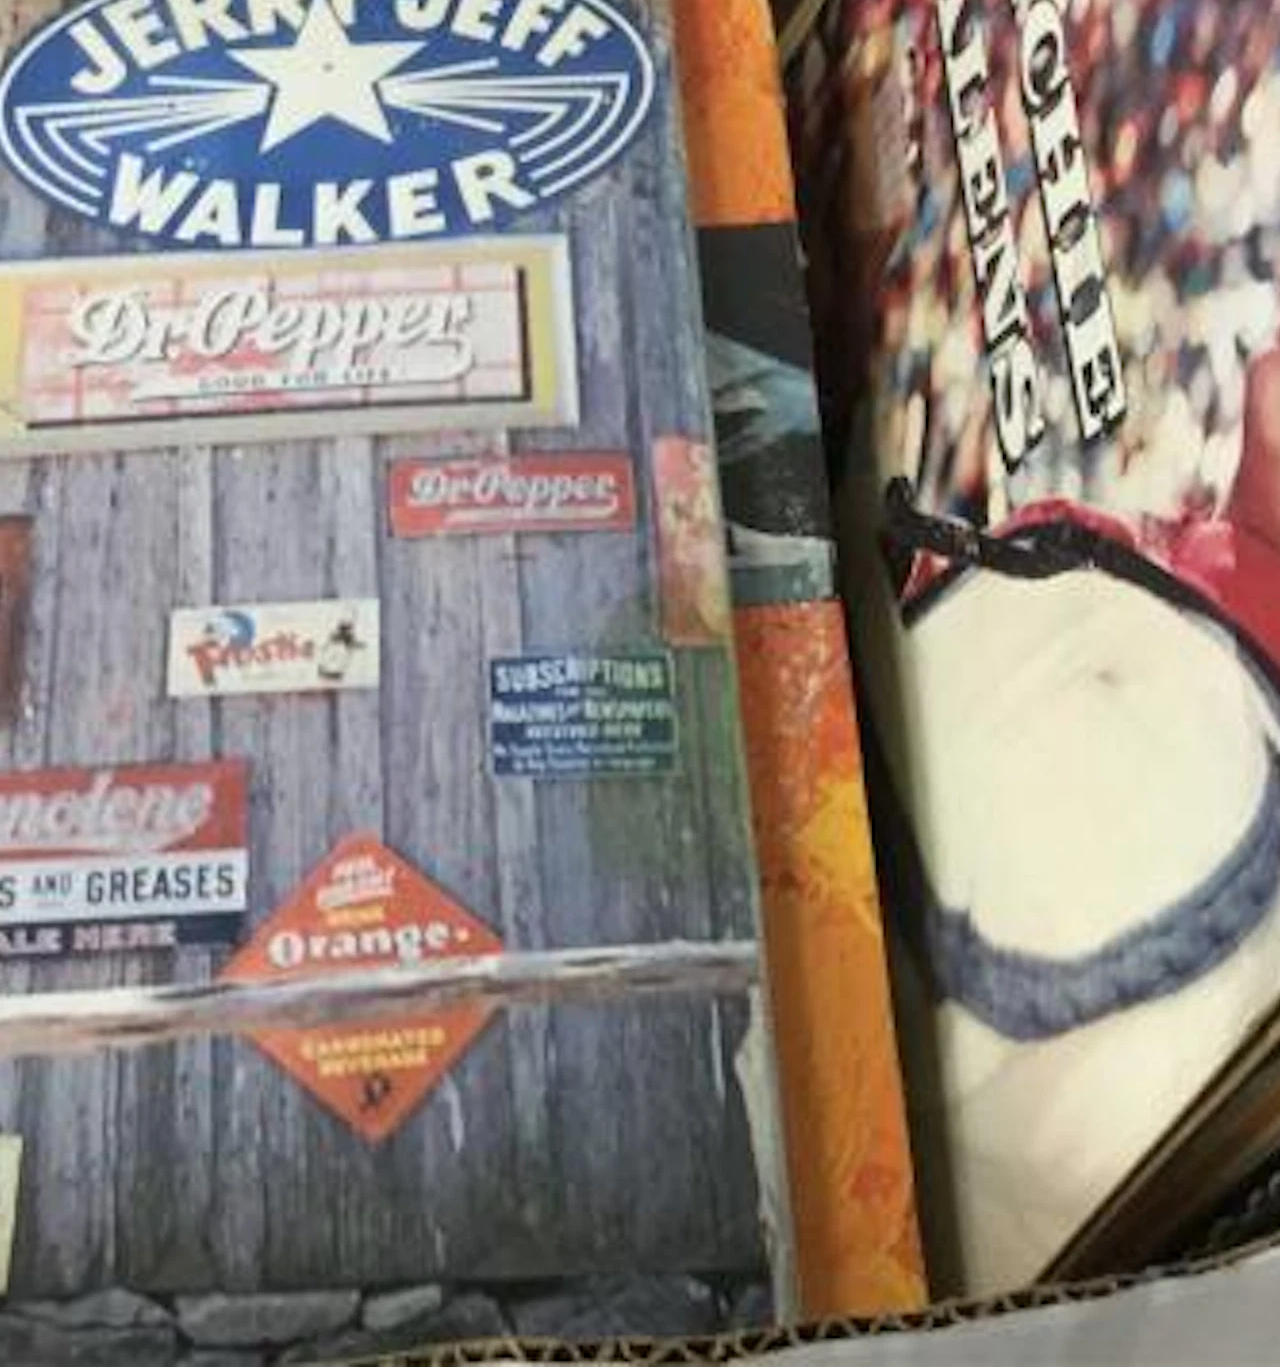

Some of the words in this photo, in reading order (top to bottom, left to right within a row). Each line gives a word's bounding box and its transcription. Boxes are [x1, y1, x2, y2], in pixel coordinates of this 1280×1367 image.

[108, 150, 537, 246] WALKER
[185, 288, 477, 381] Pepper
[32, 873, 73, 897] AND
[85, 863, 236, 904] GREASES
[72, 920, 178, 952] HERE
